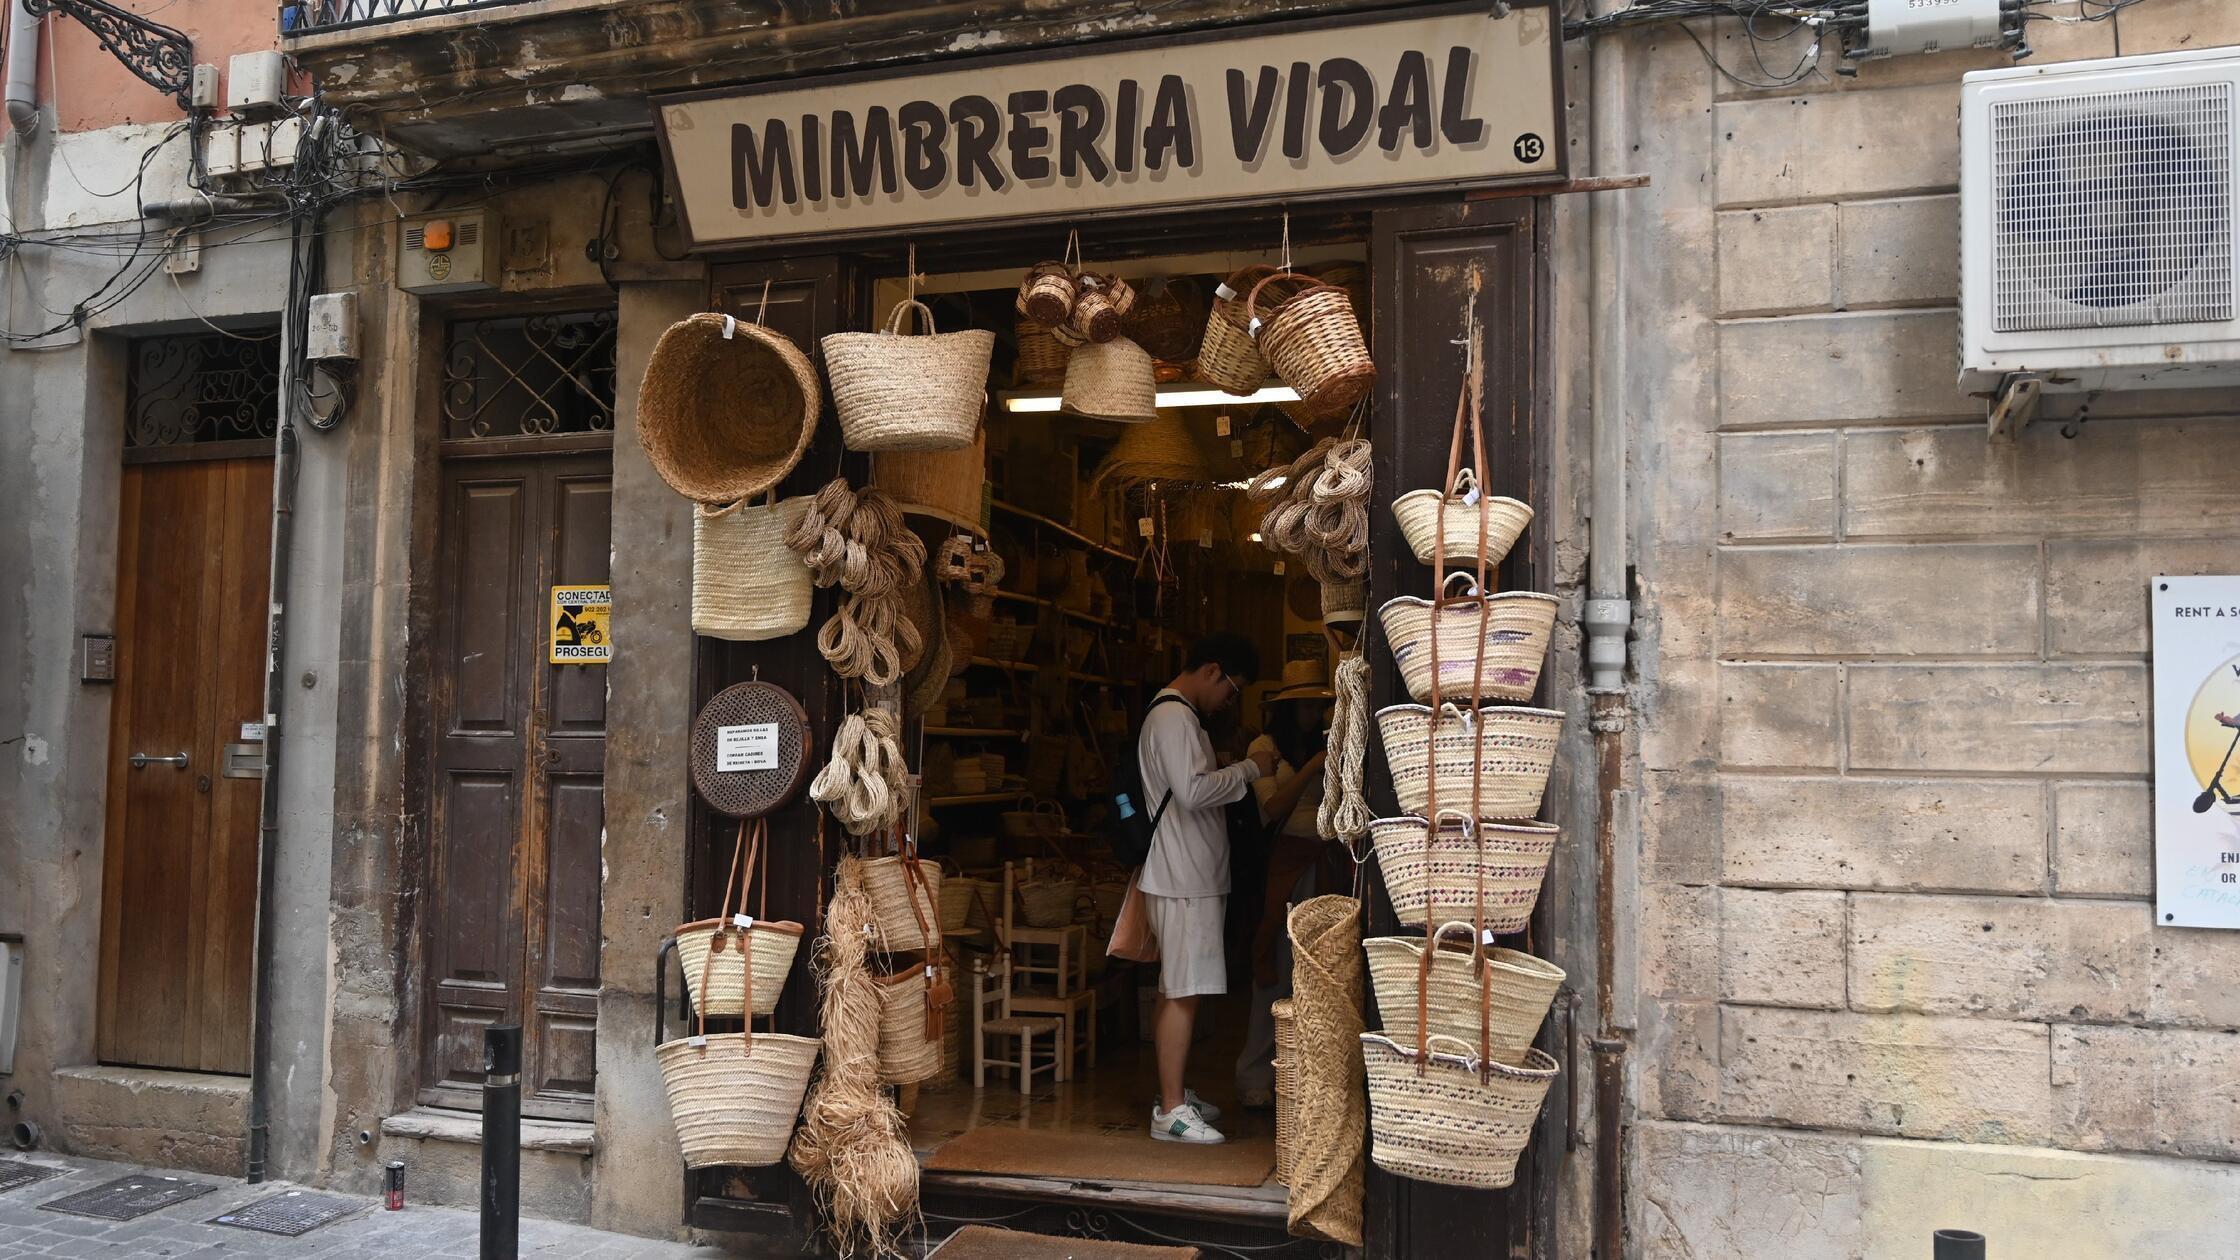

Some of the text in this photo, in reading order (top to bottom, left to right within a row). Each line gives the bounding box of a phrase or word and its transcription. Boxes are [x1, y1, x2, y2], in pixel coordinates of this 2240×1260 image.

[731, 46, 1486, 212] MIMBRERIA VIDAL
[1516, 138, 1541, 158] 13
[195, 371, 247, 402] 1890
[2175, 607, 2240, 617] RENT A S
[2221, 873, 2236, 883] OR
